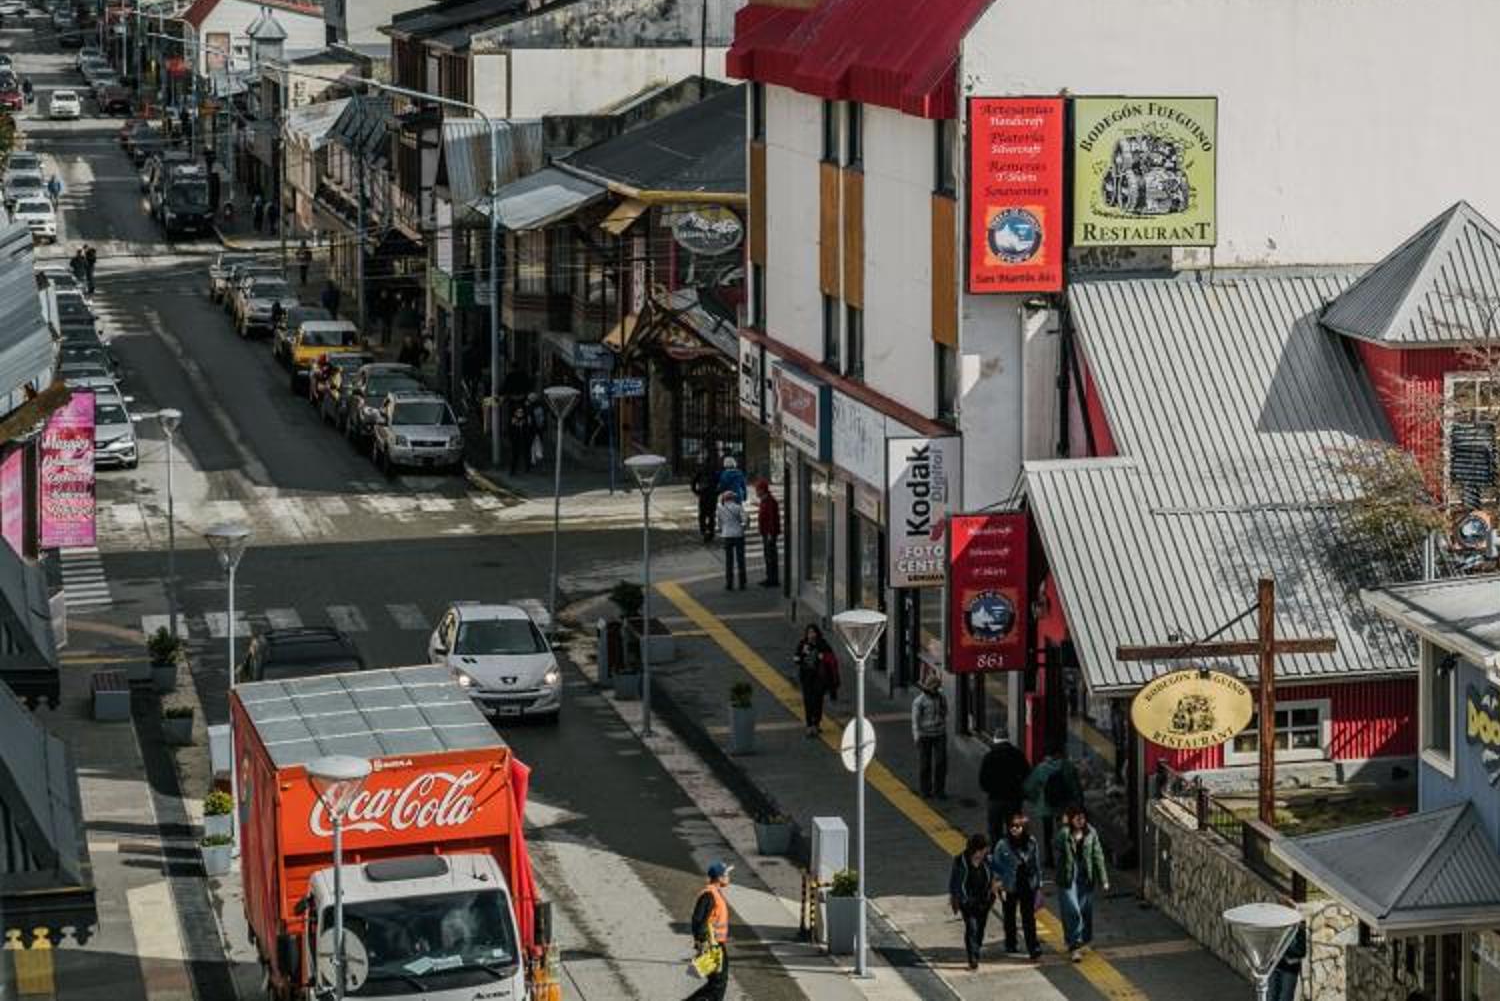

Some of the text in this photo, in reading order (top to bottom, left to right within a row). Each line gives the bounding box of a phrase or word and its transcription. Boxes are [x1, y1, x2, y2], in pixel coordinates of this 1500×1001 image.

[1148, 102, 1213, 152] FUEGUINO
[1082, 222, 1212, 241] RESTAURANT
[906, 445, 931, 537] Kodak
[897, 559, 945, 573] CENTE
